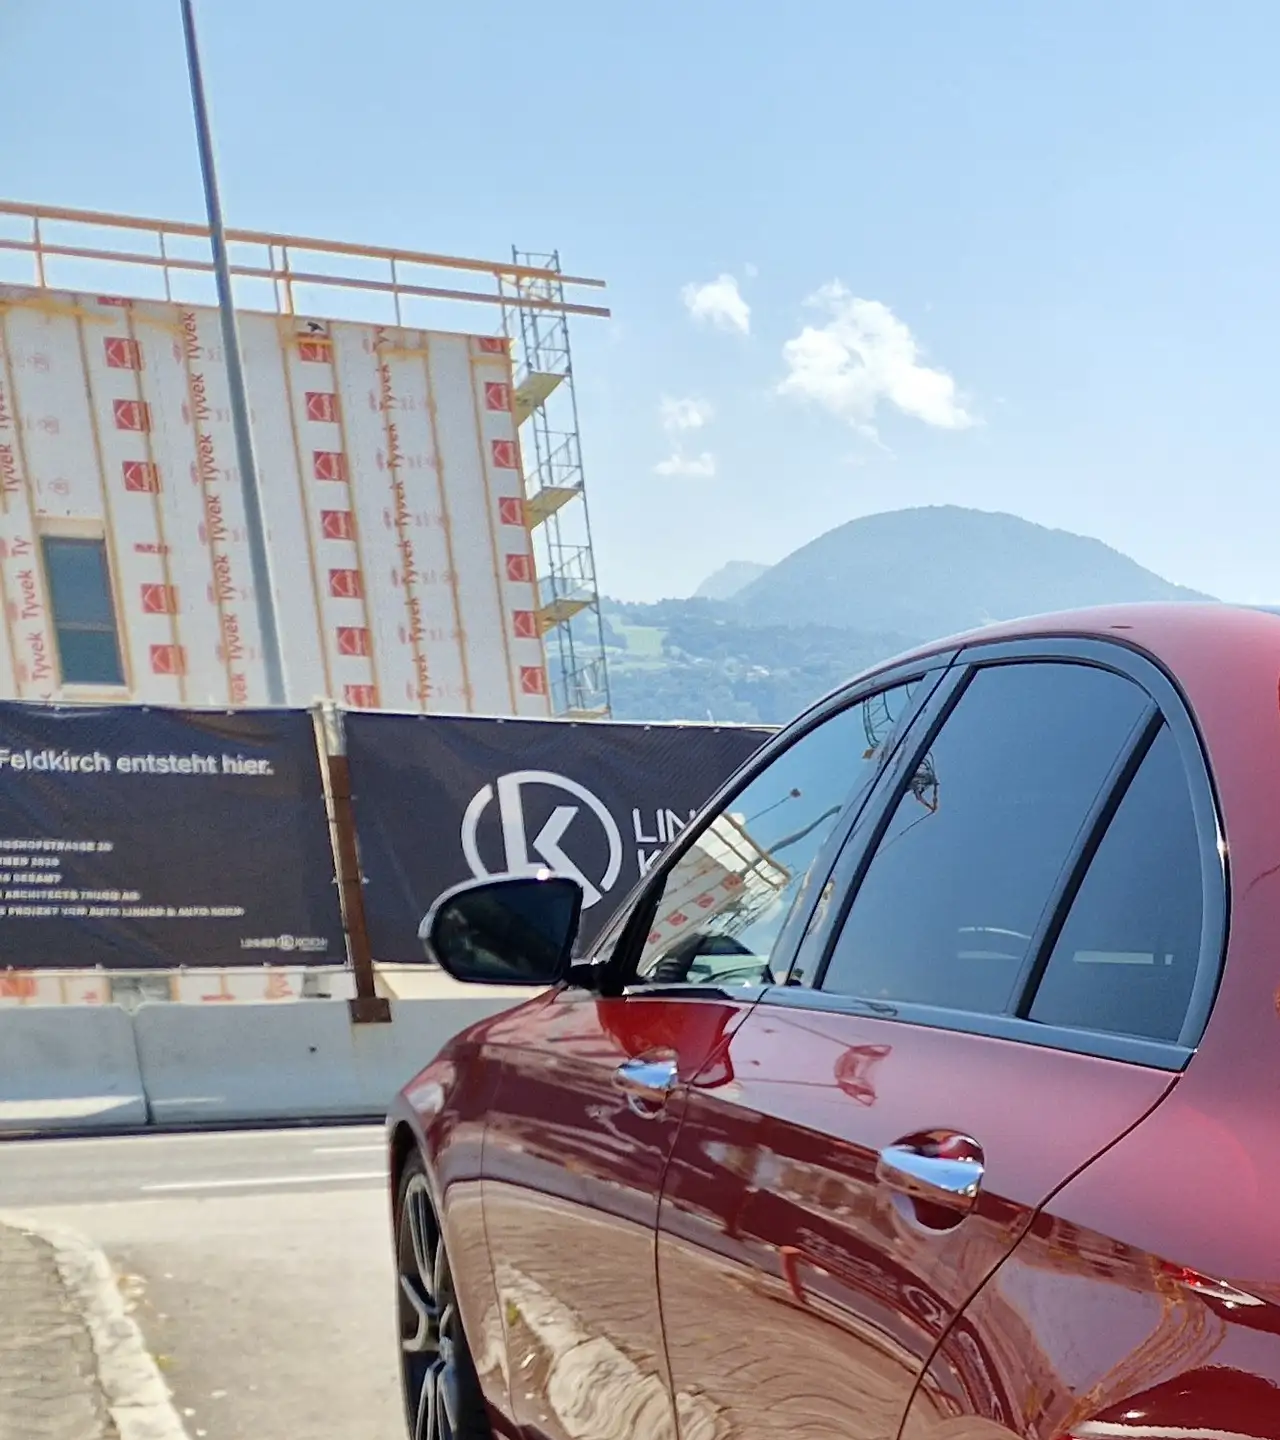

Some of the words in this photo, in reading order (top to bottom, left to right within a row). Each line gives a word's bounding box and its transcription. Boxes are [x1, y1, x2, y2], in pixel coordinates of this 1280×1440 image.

[207, 494, 230, 542] Tyvek
[16, 569, 40, 620] Tyvek
[25, 631, 52, 682] Tyvek
[225, 613, 245, 661] Tyvek
[116, 753, 218, 774] entsteht
[221, 754, 275, 776] hier.
